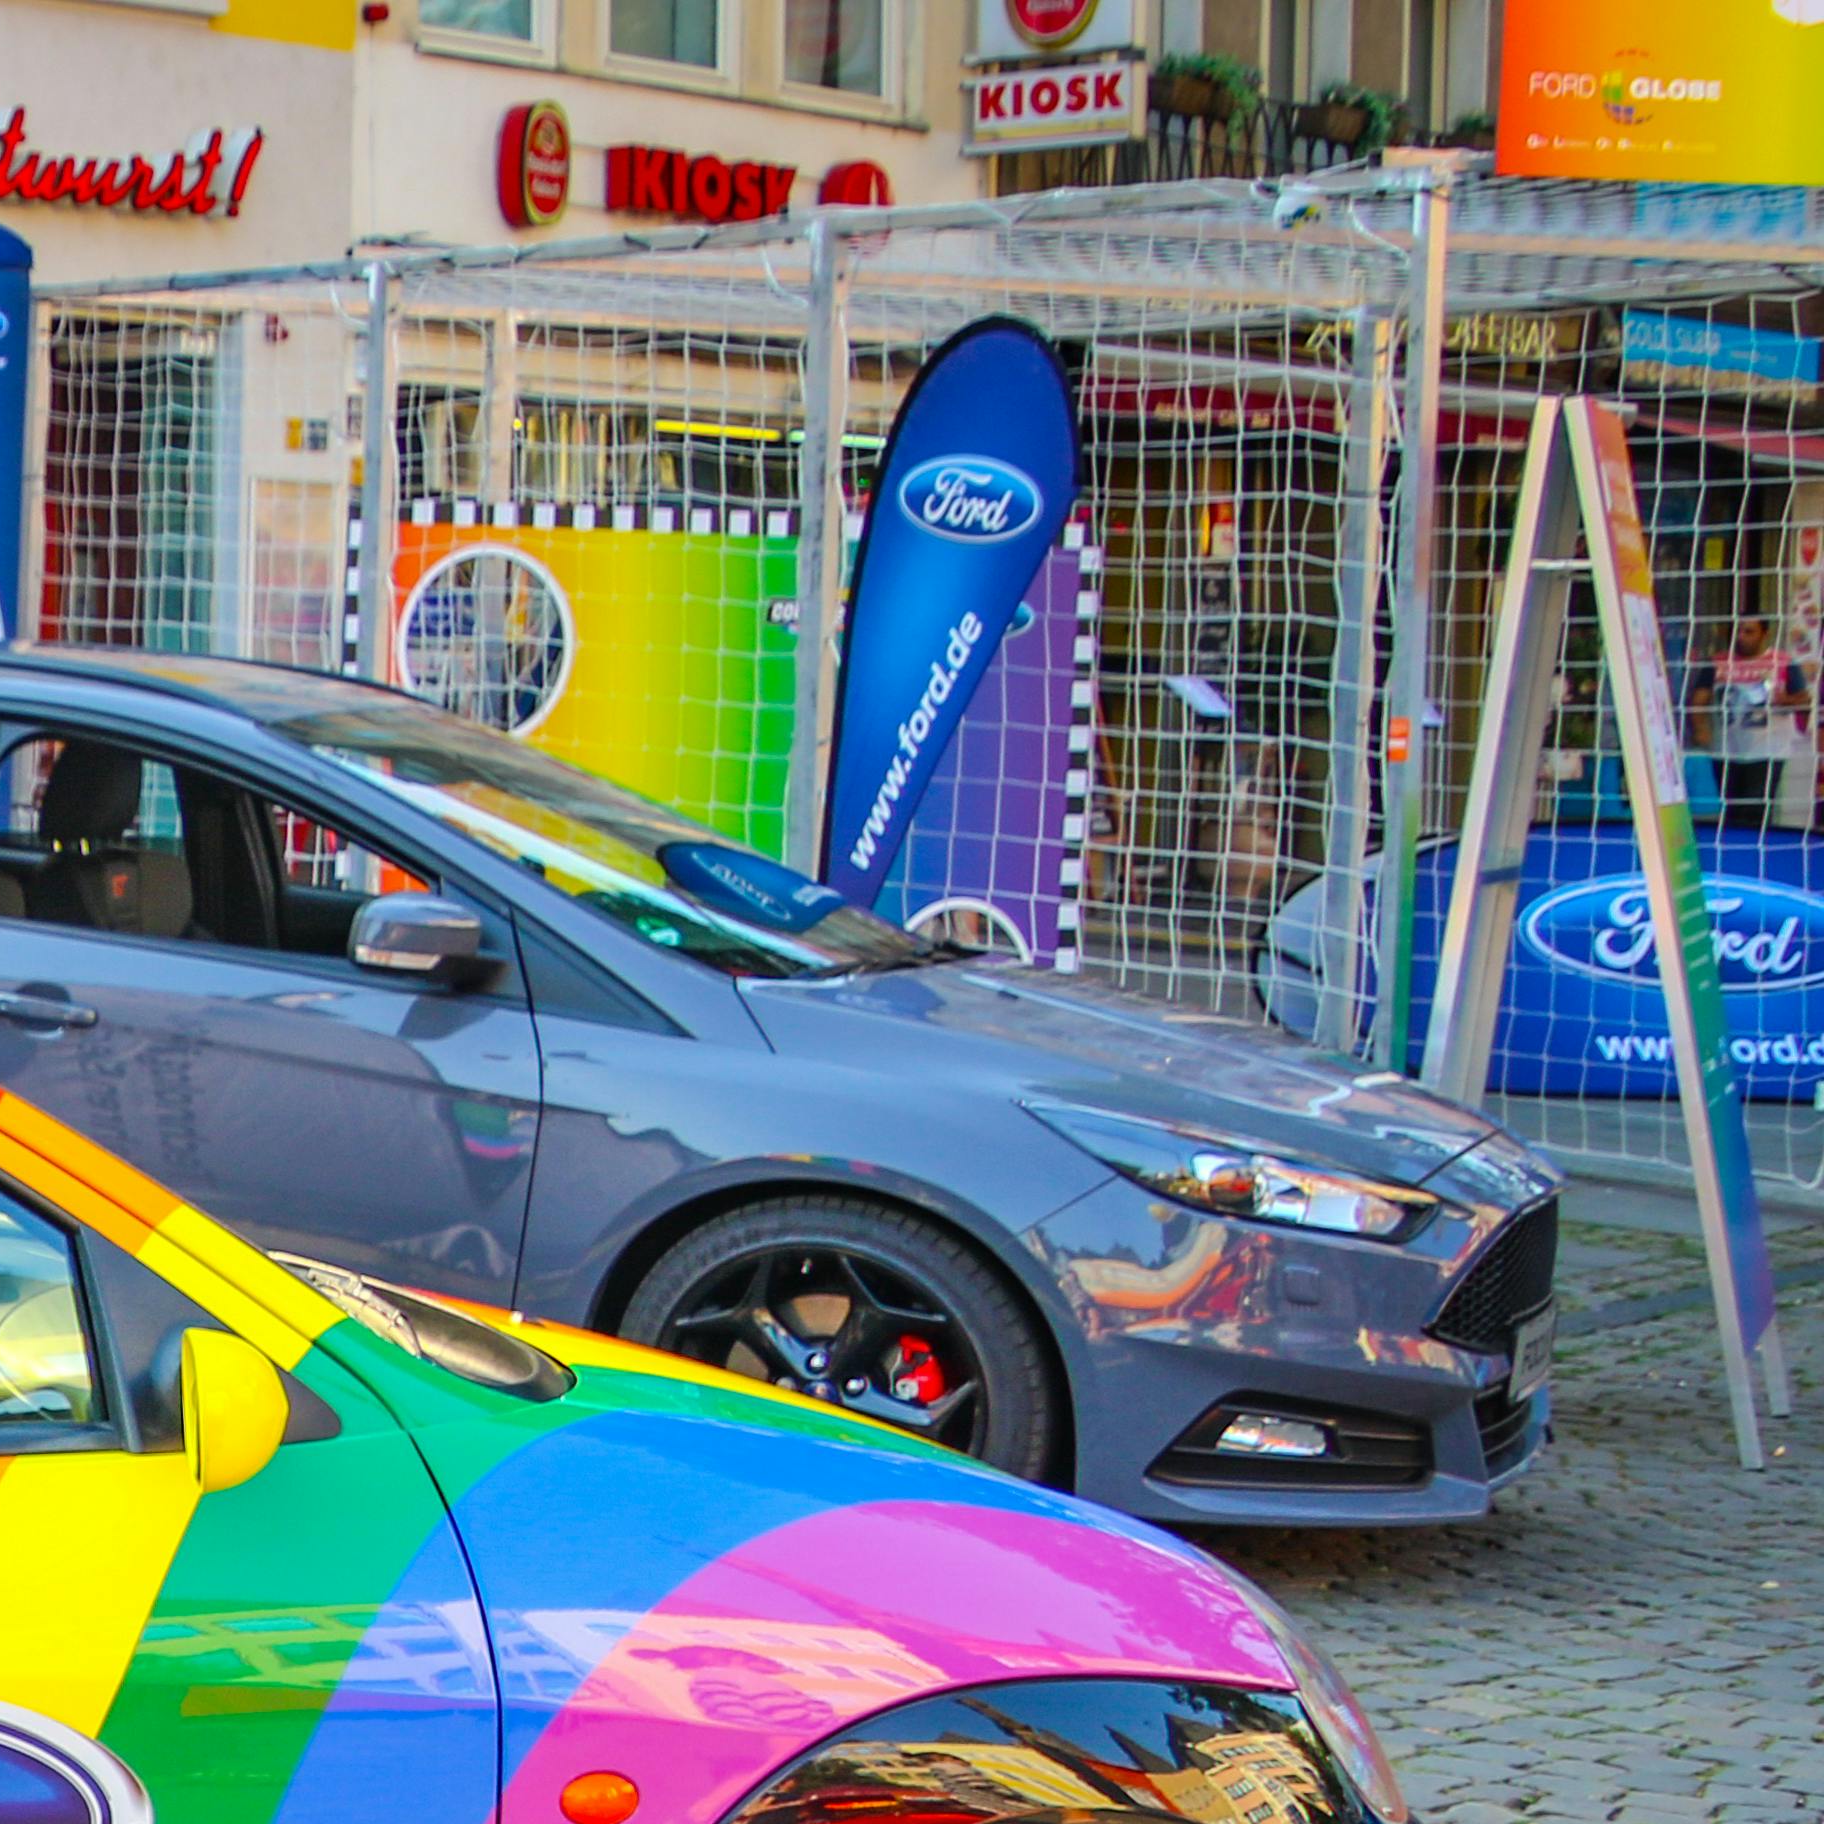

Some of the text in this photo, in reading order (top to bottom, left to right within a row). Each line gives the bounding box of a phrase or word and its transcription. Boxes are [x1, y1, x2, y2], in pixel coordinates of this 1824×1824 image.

[978, 69, 1123, 122] KIOSK
[1528, 71, 1723, 101] FORD GLOBE
[624, 143, 798, 222] KIOSK
[923, 467, 1013, 533] Ford
[849, 610, 984, 872] www.ford.de
[1594, 888, 1803, 975] Frd
